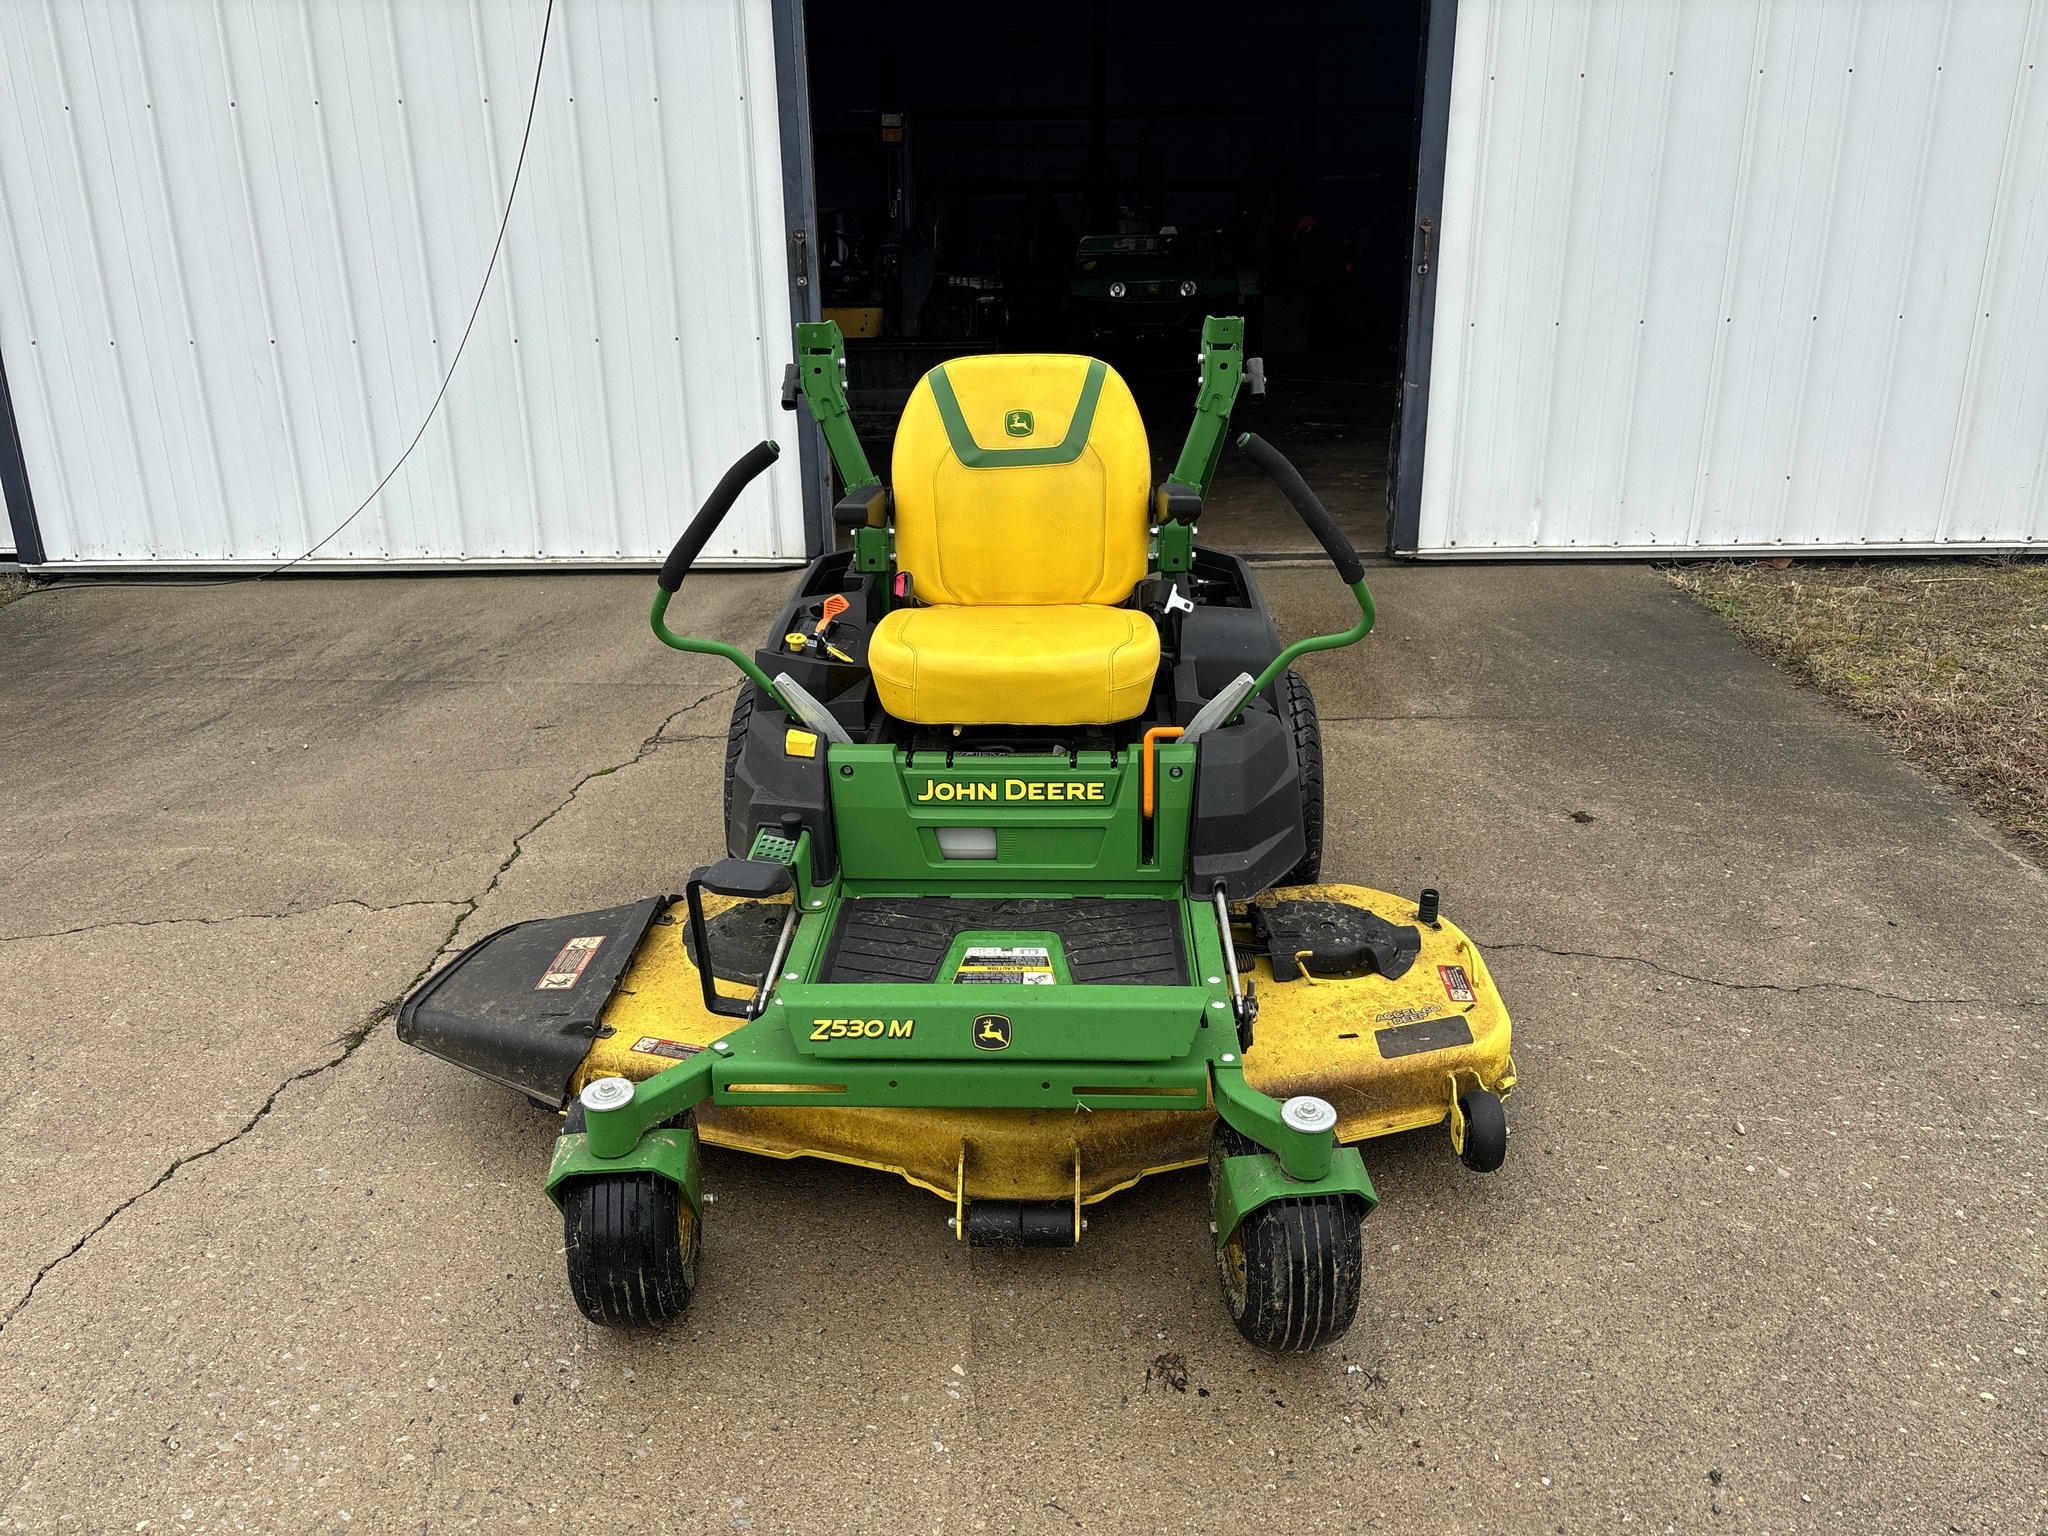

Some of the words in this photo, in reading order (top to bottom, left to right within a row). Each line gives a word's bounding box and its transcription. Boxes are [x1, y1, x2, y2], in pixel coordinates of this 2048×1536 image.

[917, 779, 998, 801] JOHN
[1004, 778, 1105, 801] DEERE
[1392, 1011, 1428, 1025] DEEP
[809, 1019, 886, 1041] Z530
[888, 1019, 916, 1039] M
